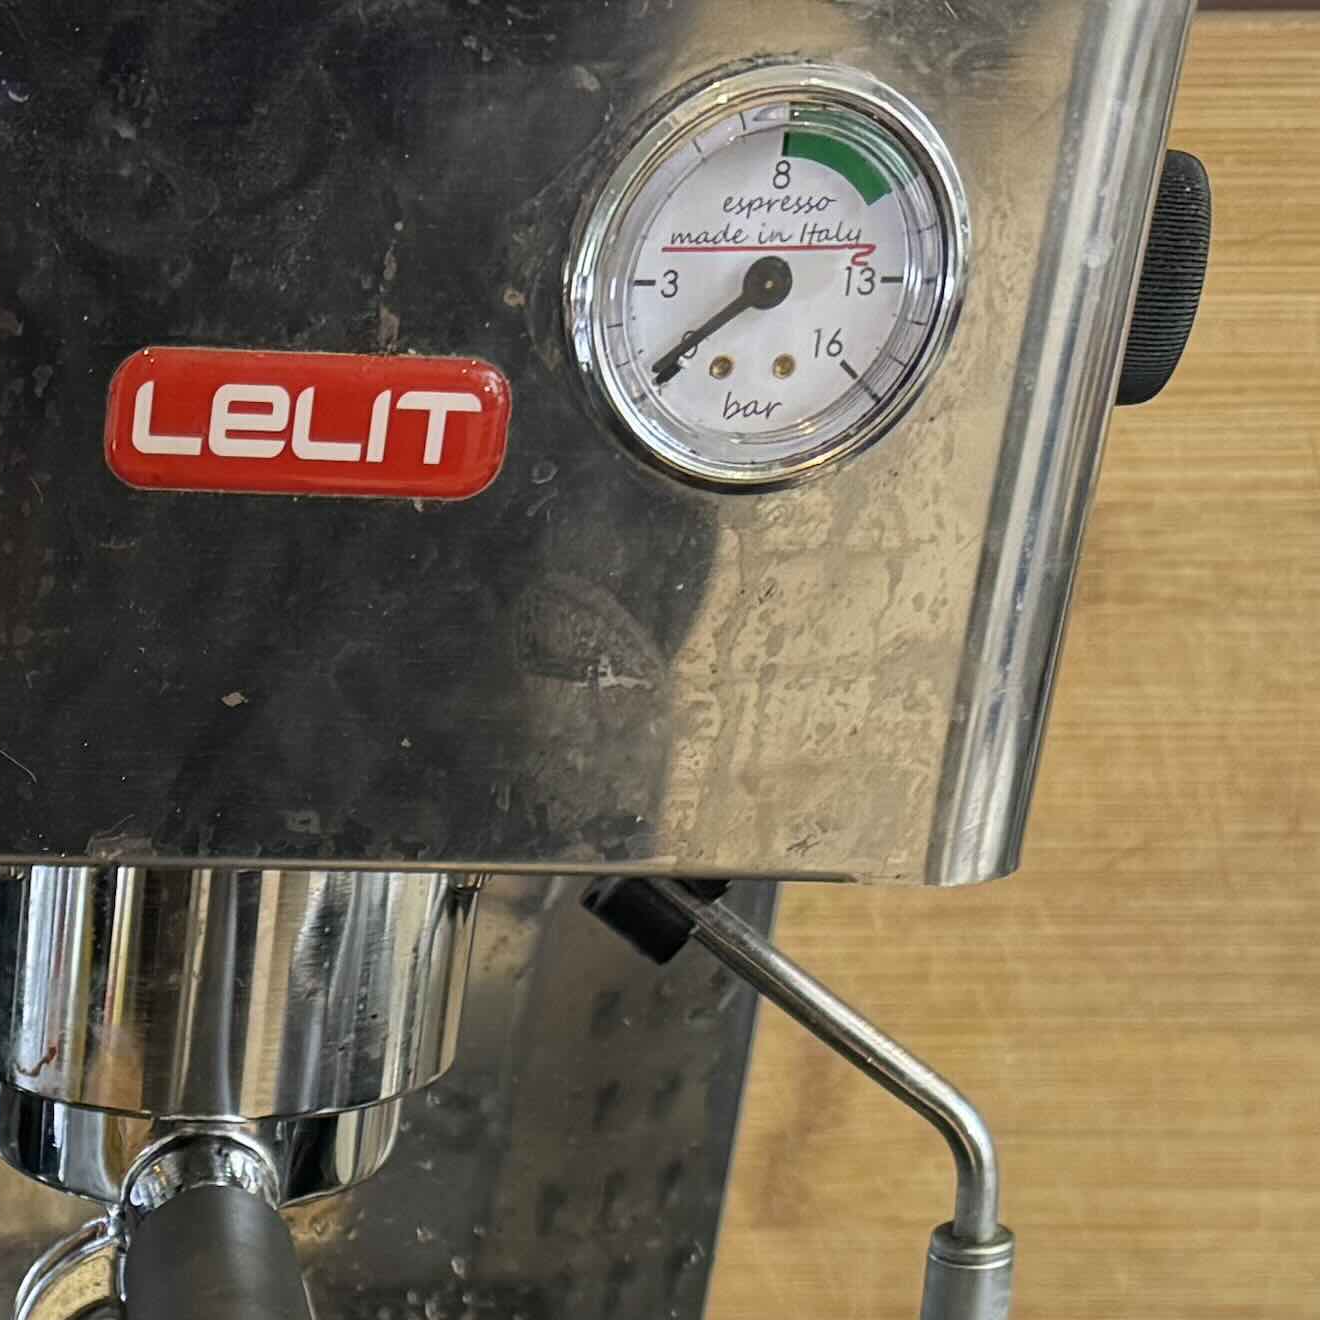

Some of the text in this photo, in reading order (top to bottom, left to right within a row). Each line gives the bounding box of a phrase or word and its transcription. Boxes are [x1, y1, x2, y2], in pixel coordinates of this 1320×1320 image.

[772, 159, 792, 189] 8
[722, 193, 837, 219] espresso
[670, 222, 862, 246] made in Italy
[659, 265, 877, 299] 3 13
[813, 326, 844, 359] 16
[722, 391, 784, 421] bar
